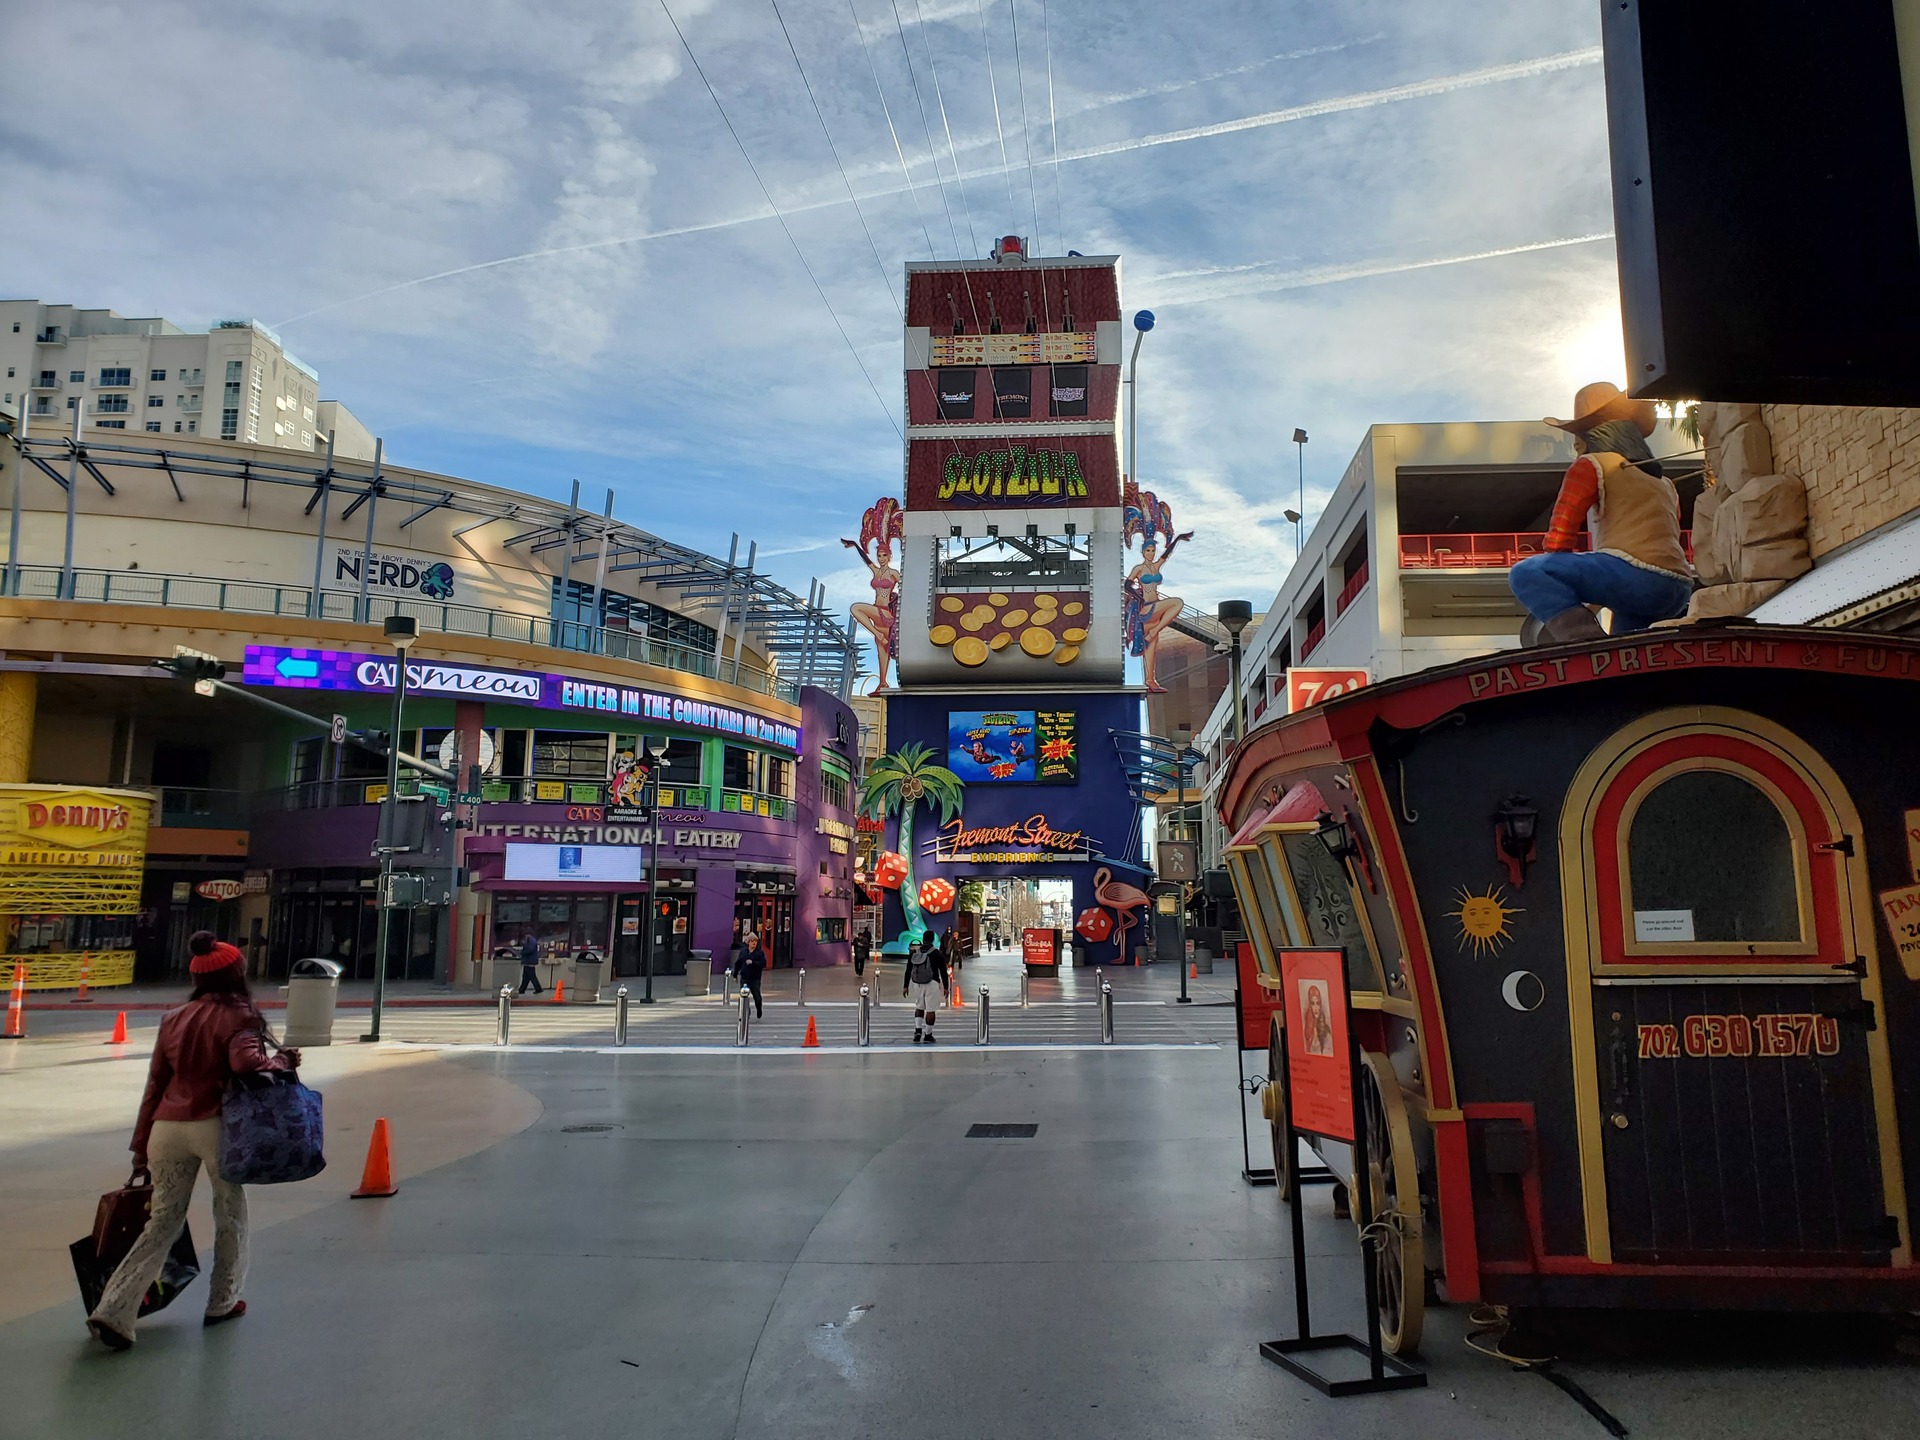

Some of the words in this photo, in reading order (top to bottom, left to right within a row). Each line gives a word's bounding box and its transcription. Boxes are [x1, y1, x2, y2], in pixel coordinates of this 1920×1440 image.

[936, 443, 1090, 500] SLOTZILLA
[337, 548, 351, 556] 2ND
[381, 554, 404, 564] ABOVE
[406, 558, 432, 567] DENNY'S
[336, 555, 420, 589] NERD
[1468, 656, 1569, 698] PAST
[1590, 639, 1781, 676] PRESENT
[1801, 642, 1820, 666] &
[422, 667, 538, 698] meow
[562, 680, 618, 712] ENTER
[621, 689, 640, 715] IN
[643, 693, 671, 720] THE
[673, 698, 744, 734] COURTYARD
[744, 714, 758, 738] ON
[775, 724, 798, 749] FLOOR
[466, 796, 481, 804] 400
[27, 804, 129, 832] Denny's
[608, 815, 648, 823] ENTERTAINMENT
[674, 829, 743, 849] EATERY
[944, 817, 1020, 859] Fremont
[1018, 813, 1082, 850] Street
[8, 852, 89, 864] AMERICA'S
[97, 854, 132, 865] DINER
[970, 852, 1054, 863] EXPERIENCE
[203, 882, 241, 896] TATTOO
[1884, 893, 1920, 920] TAR
[1638, 1024, 1681, 1059] 702
[1752, 1013, 1840, 1057] 1570
